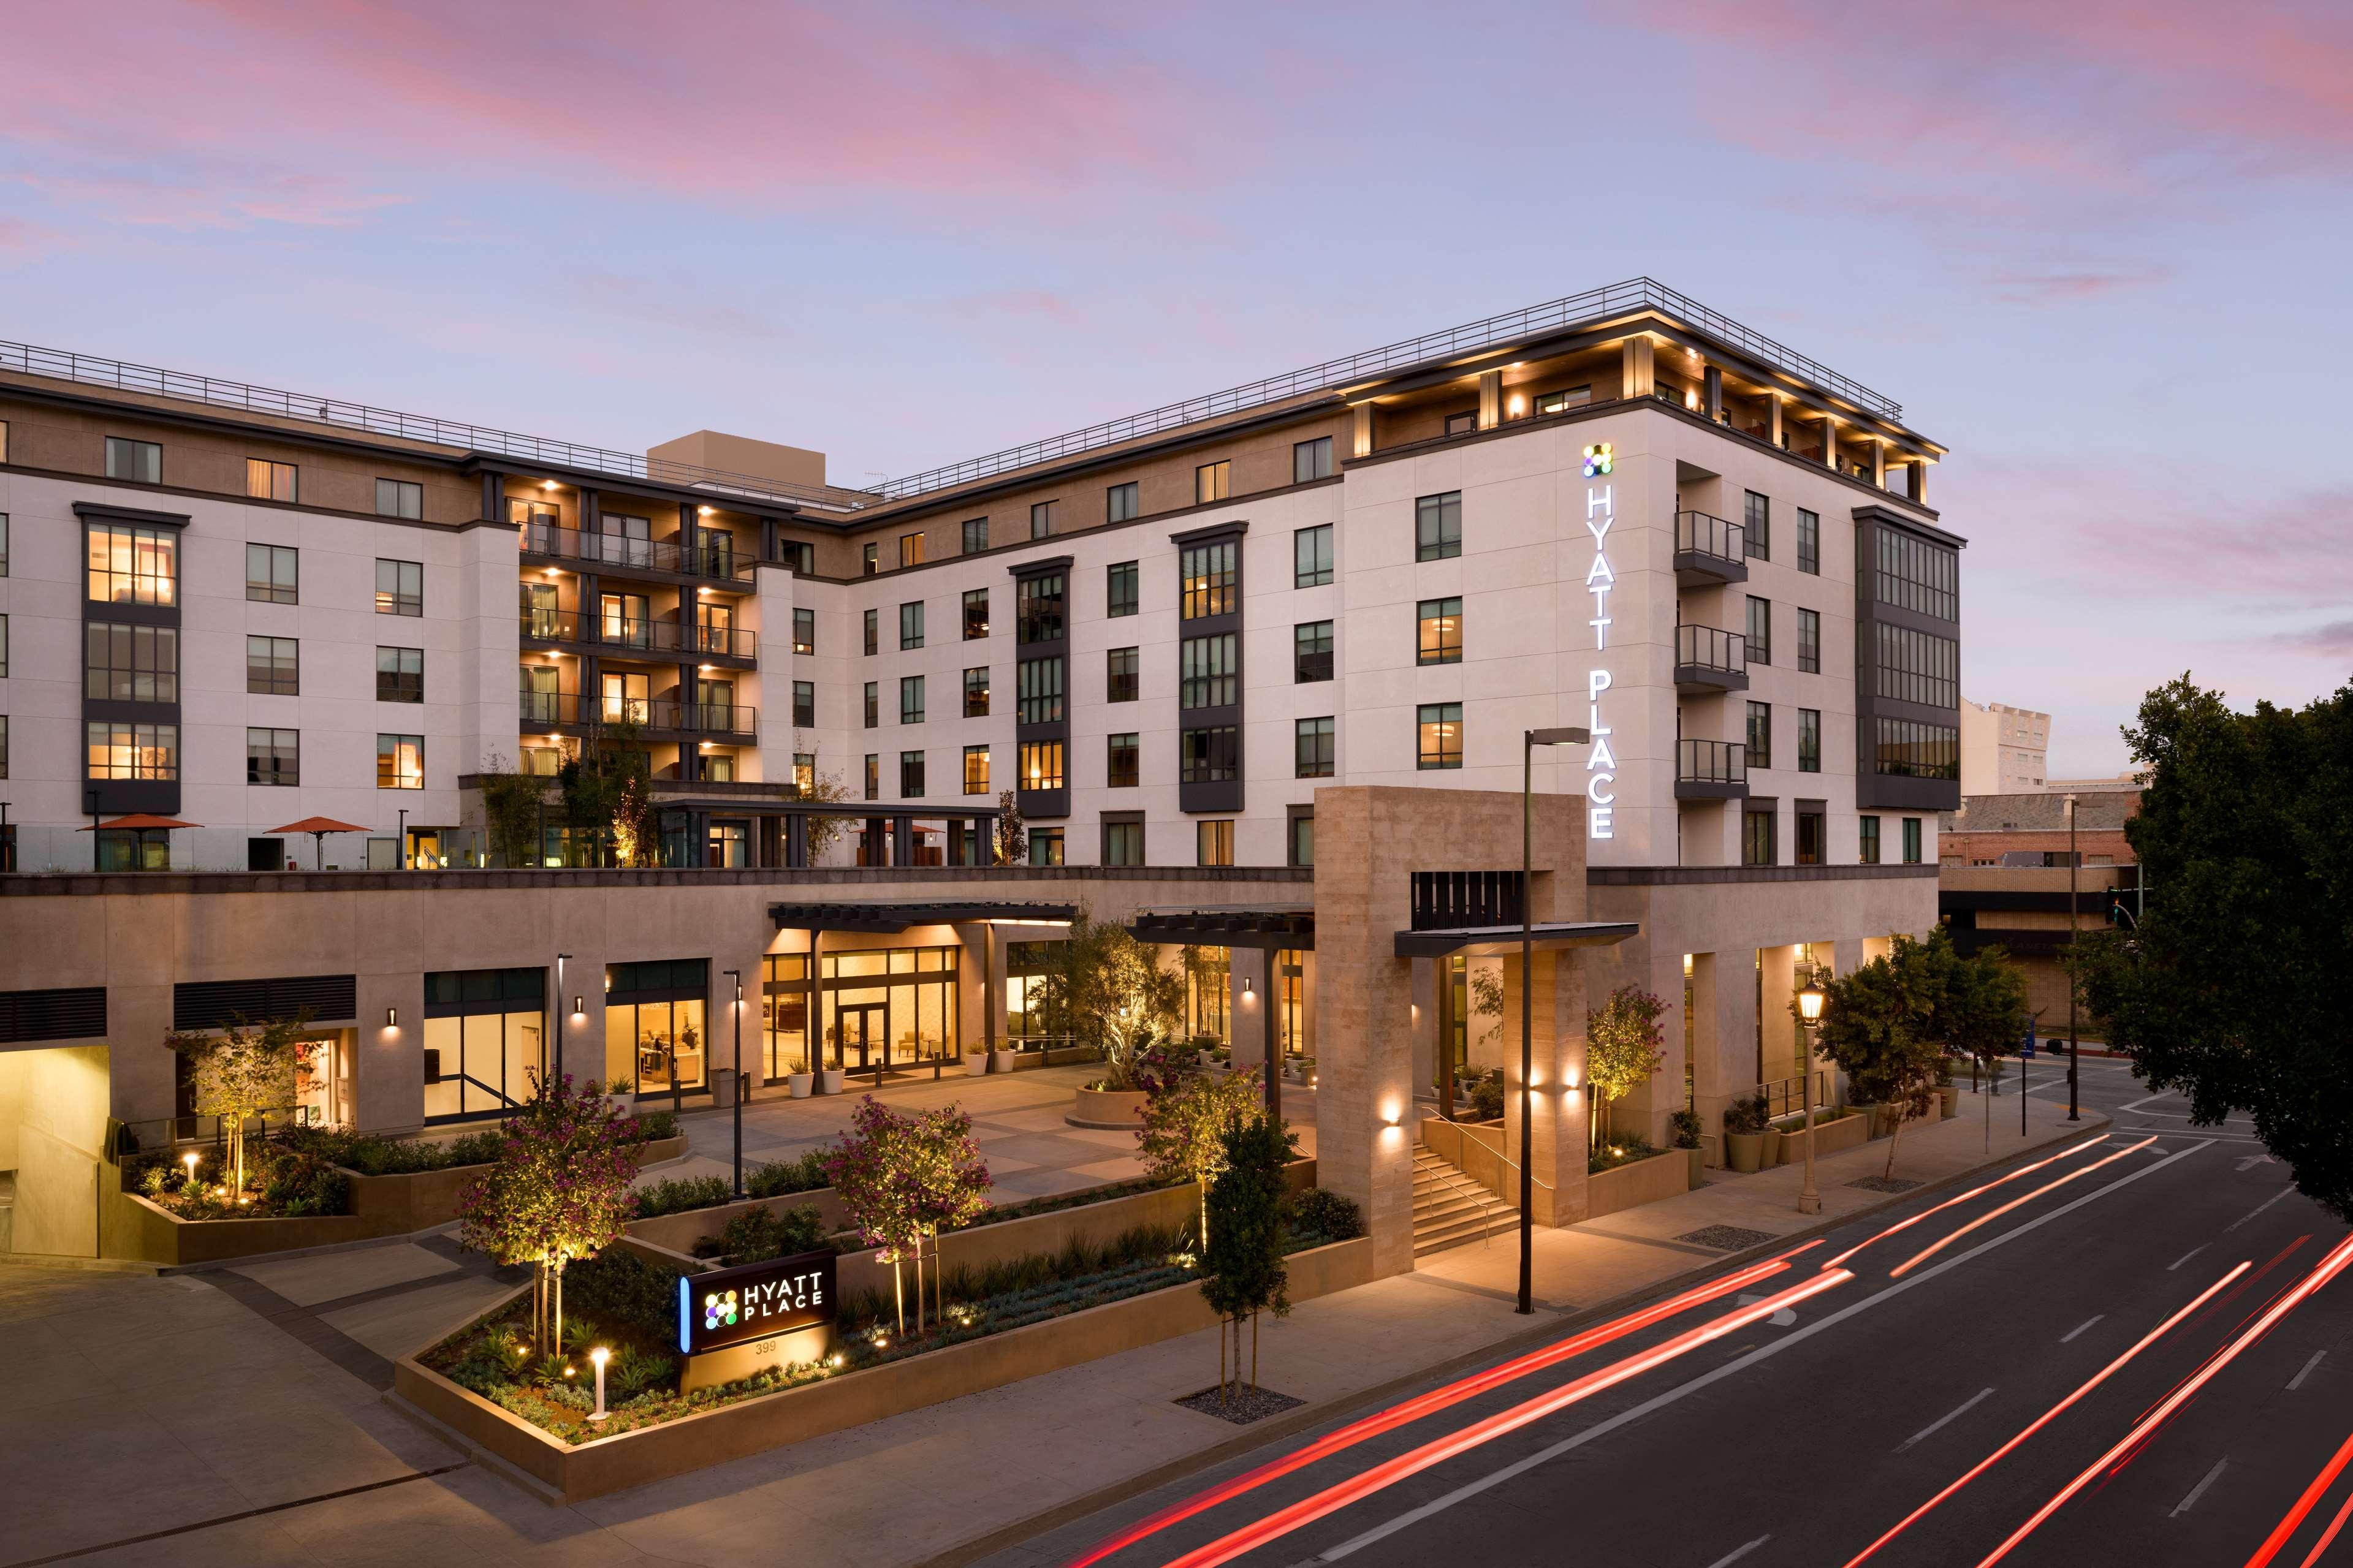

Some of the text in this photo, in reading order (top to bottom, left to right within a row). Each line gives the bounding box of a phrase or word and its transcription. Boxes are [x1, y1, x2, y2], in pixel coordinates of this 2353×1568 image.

[1586, 485, 1616, 839] HYATT PLACE
[745, 1272, 822, 1305] HYATT
[745, 1291, 822, 1320] PLACE
[756, 1341, 776, 1355] 399
